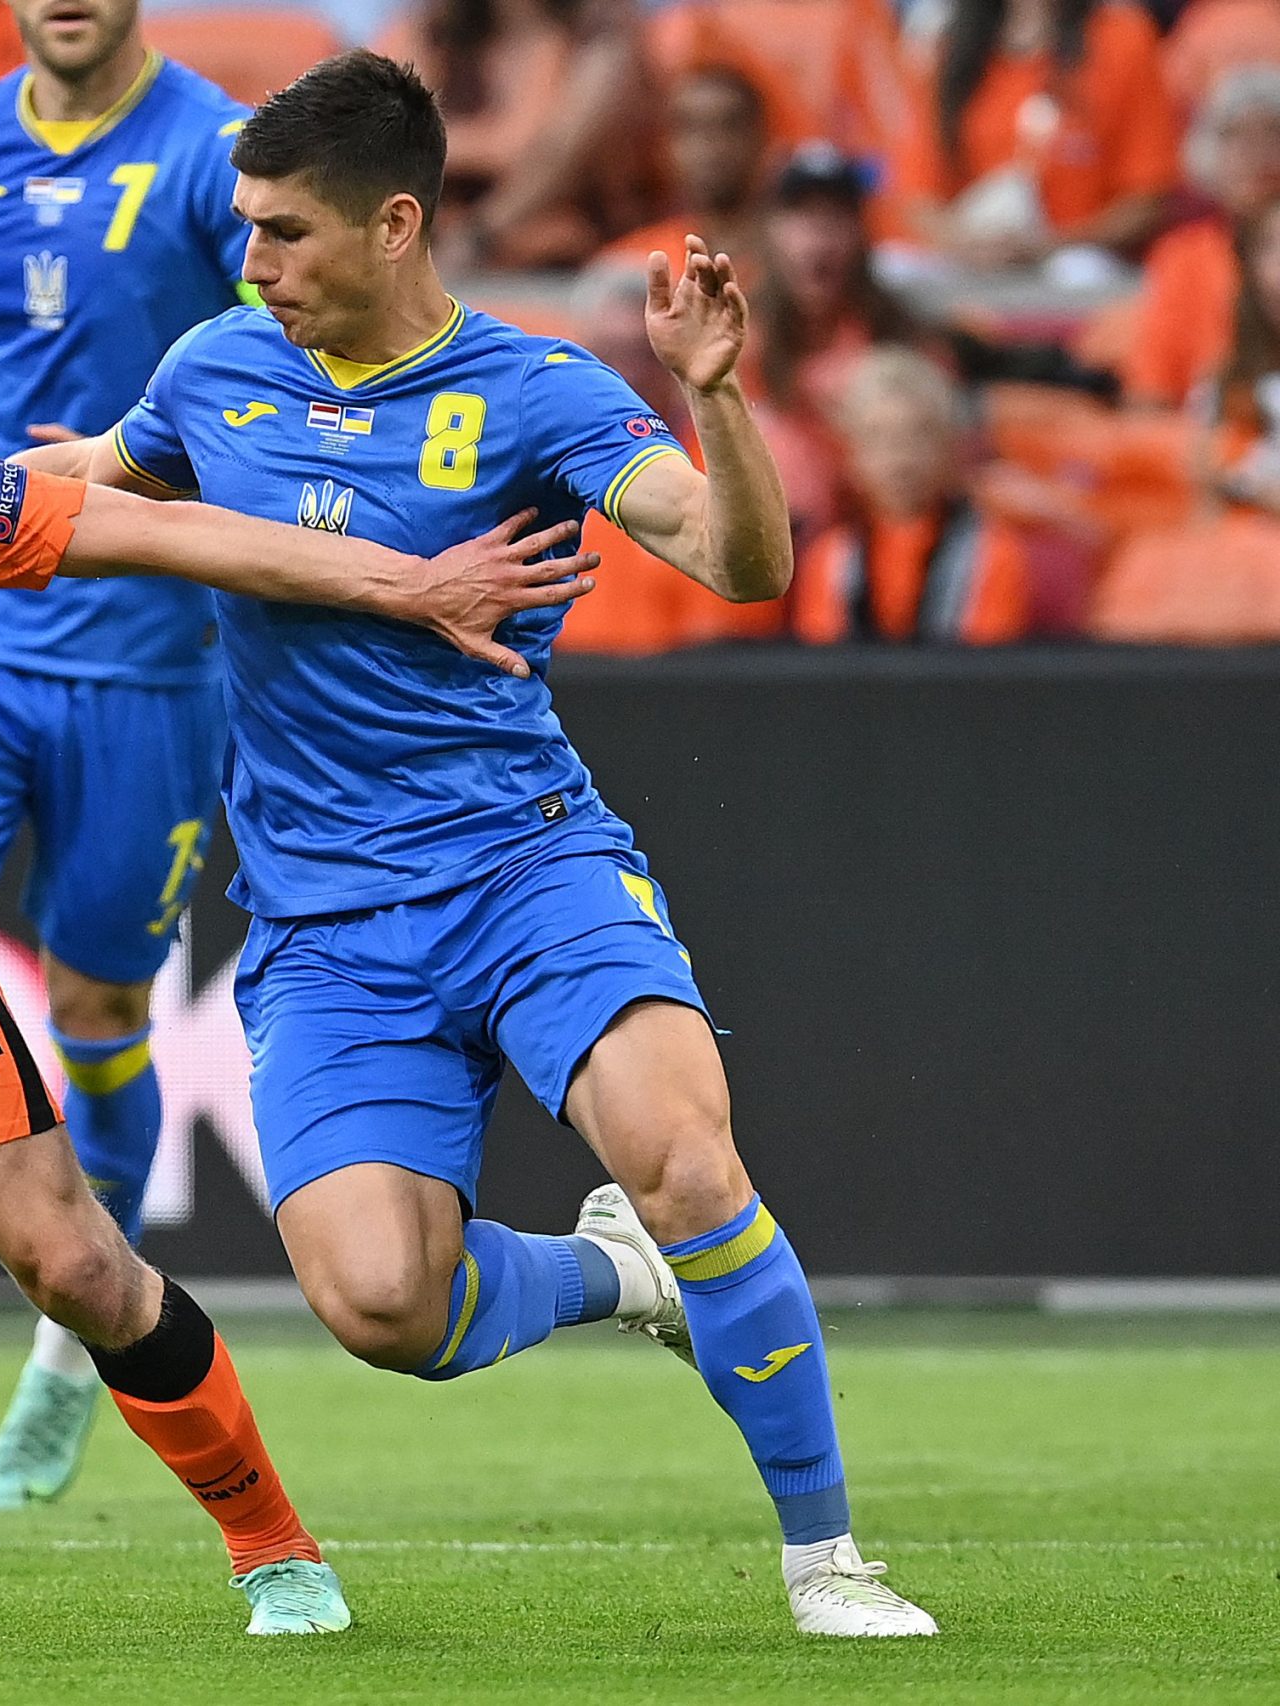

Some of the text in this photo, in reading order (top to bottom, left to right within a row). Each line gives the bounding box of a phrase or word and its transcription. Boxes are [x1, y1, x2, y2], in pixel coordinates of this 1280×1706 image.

[103, 163, 158, 252] 7
[417, 391, 487, 490] 8
[198, 1468, 259, 1501] KNVB
